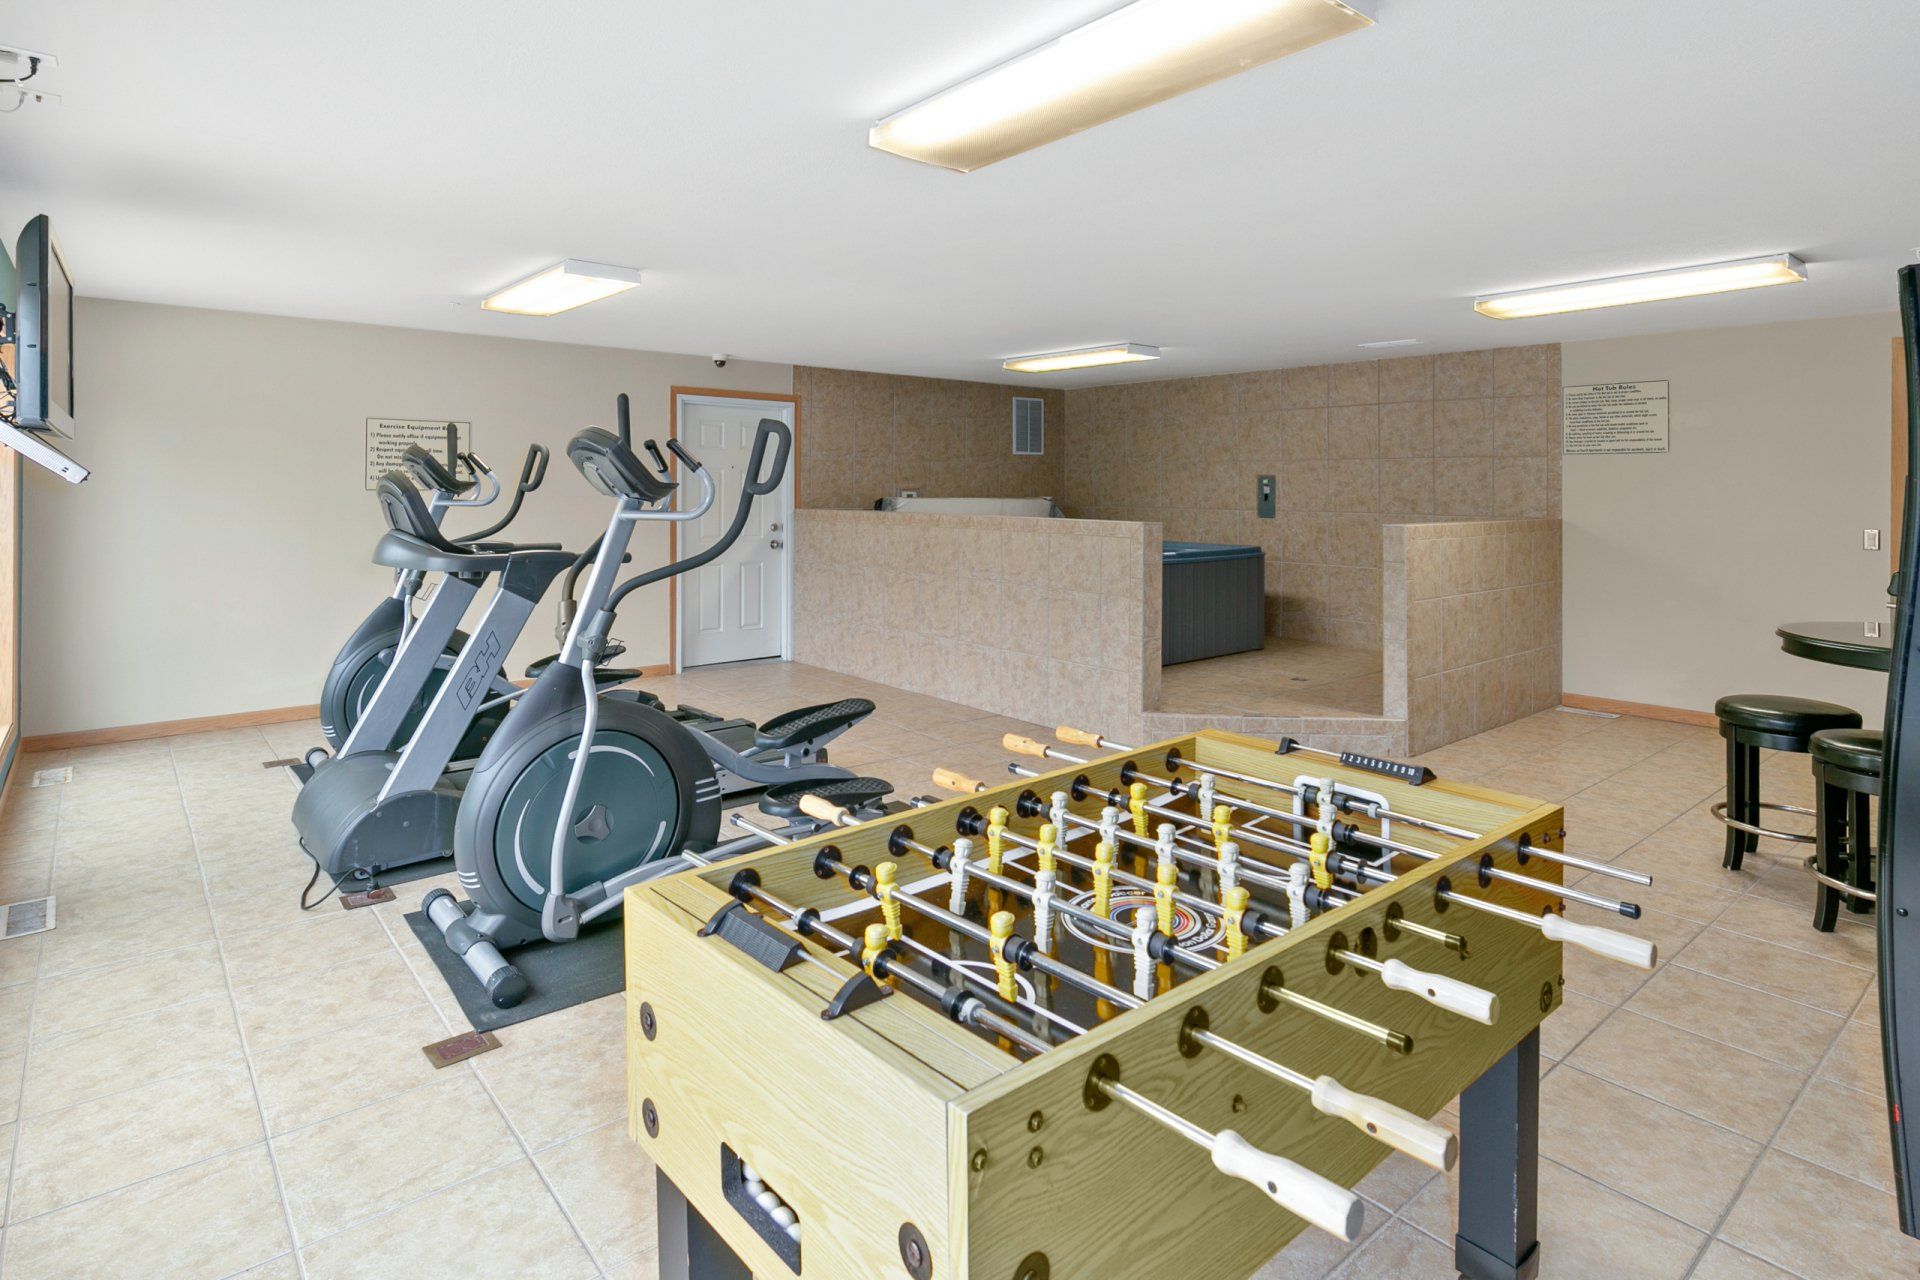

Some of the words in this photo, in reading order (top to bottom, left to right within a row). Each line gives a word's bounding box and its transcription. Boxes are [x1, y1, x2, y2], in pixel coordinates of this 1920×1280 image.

[456, 630, 501, 711] BH
[1377, 761, 1383, 769] 6
[1400, 766, 1406, 774] 9
[1408, 768, 1415, 776] 10
